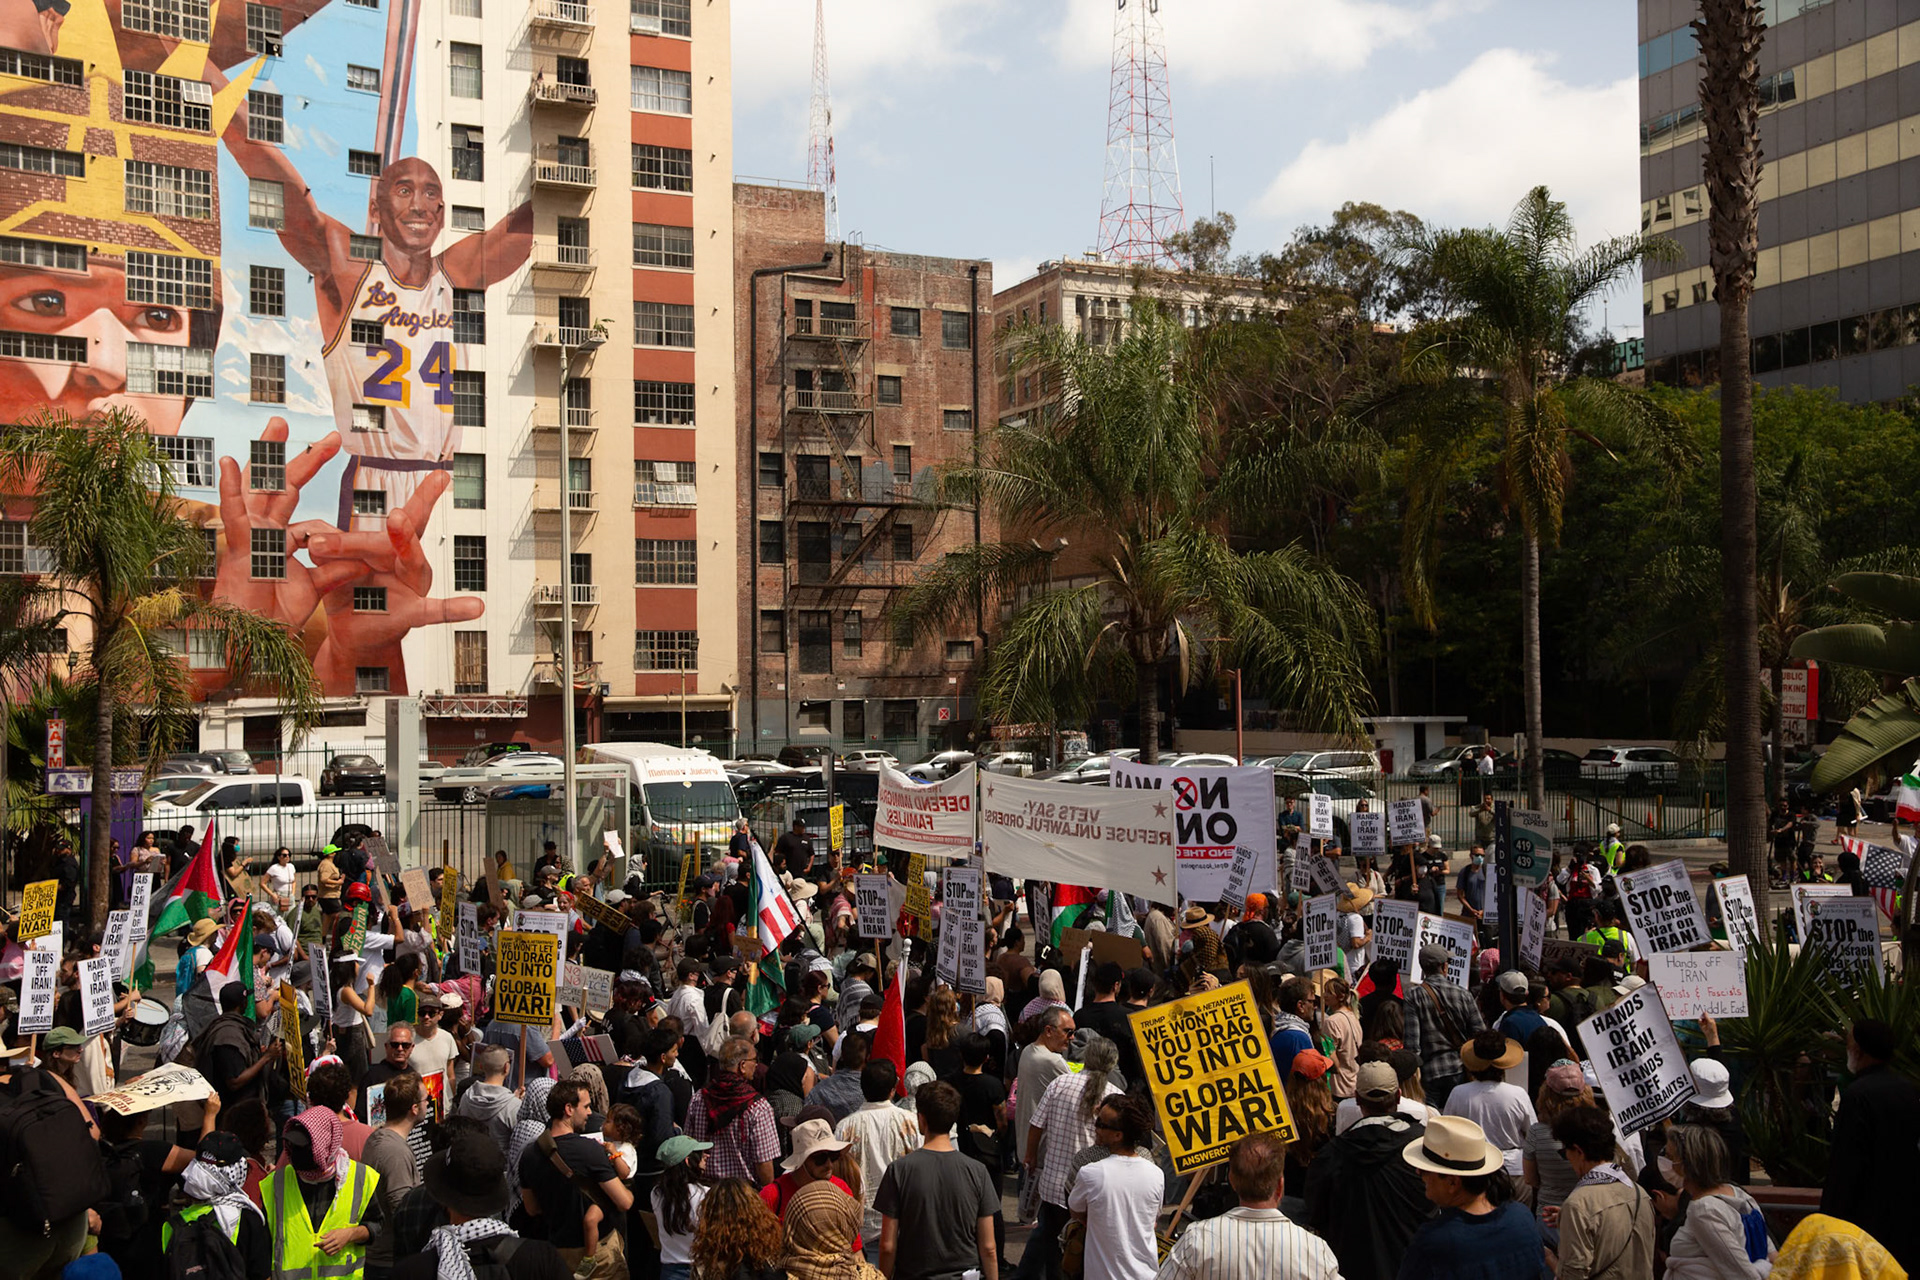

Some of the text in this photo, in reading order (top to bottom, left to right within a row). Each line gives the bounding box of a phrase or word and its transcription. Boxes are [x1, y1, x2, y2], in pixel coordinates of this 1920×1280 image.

[361, 281, 396, 308] Los
[363, 339, 457, 413] 24
[1783, 672, 1803, 680] UBLIC
[1783, 685, 1806, 693] RKING
[49, 731, 62, 767] ATM
[1315, 808, 1329, 816] IRAN!
[1393, 801, 1416, 809] HANDS
[1395, 813, 1416, 822] IRAN!
[1357, 826, 1378, 834] IRAN!
[1516, 840, 1531, 851] 419
[1516, 856, 1532, 867] 439
[946, 881, 975, 899] STOP the
[36, 898, 53, 909] INTO
[857, 890, 877, 906] STOP
[1627, 885, 1691, 915] STOP the
[22, 910, 51, 922] GLOBAL
[1635, 903, 1695, 928] U.S. Israeli
[1725, 898, 1743, 921] STOP
[21, 919, 50, 934] WAR!
[862, 916, 875, 924] War
[1306, 913, 1327, 934] STOP
[1375, 916, 1413, 937] STOP the
[1645, 917, 1694, 938] War on
[863, 924, 886, 935] IRAN!
[1811, 919, 1874, 942] STOP the
[1306, 932, 1334, 945] U.S. Israeli
[1375, 935, 1412, 948] U.S. Israeli
[1420, 931, 1467, 958] STOP the
[1649, 927, 1700, 953] IRAN!
[501, 942, 511, 951] WE
[514, 942, 538, 952] WON'T
[1309, 943, 1332, 954] War on
[1377, 945, 1407, 958] War on
[32, 953, 54, 964] HANDS
[501, 950, 552, 964] YOU DRAG
[1309, 951, 1333, 967] IRAN!
[1666, 953, 1697, 968] Hands
[35, 966, 48, 976] OFF
[87, 958, 107, 972] HANDS
[500, 962, 552, 978] US INTO
[1447, 968, 1460, 977] on
[31, 978, 52, 989] IRAN!
[92, 971, 104, 981] OFF
[589, 972, 609, 982] WAR
[1680, 969, 1708, 983] IRAN
[90, 980, 109, 995] IRAN!
[500, 980, 551, 996] GLOBAL
[588, 981, 608, 993] ICE
[1656, 985, 1690, 999] Zionists
[1707, 985, 1742, 997] Fascists
[31, 994, 50, 1003] HANDS
[92, 995, 110, 1007] HANDS
[499, 993, 551, 1015] WAR!
[33, 1005, 44, 1015] OFF
[96, 1007, 107, 1017] OFF
[1140, 1016, 1165, 1028] TRUMP
[1202, 993, 1246, 1011] NETANYAHU:
[1592, 993, 1644, 1035] HANDS
[1667, 1001, 1746, 1016] ut Middle East
[1142, 1001, 1247, 1043] WE WON'T LET
[1146, 1015, 1253, 1061] YOU DRAG
[1609, 1020, 1637, 1046] OFF
[1606, 1027, 1657, 1070] IRAN!
[1153, 1034, 1262, 1085] US INTO
[1617, 1052, 1664, 1088] HANDS
[1164, 1068, 1273, 1118] GLOBAL
[1634, 1074, 1661, 1099] OFF
[1618, 1074, 1689, 1124] IMMIGRANTS!
[1169, 1092, 1285, 1152] WAR!
